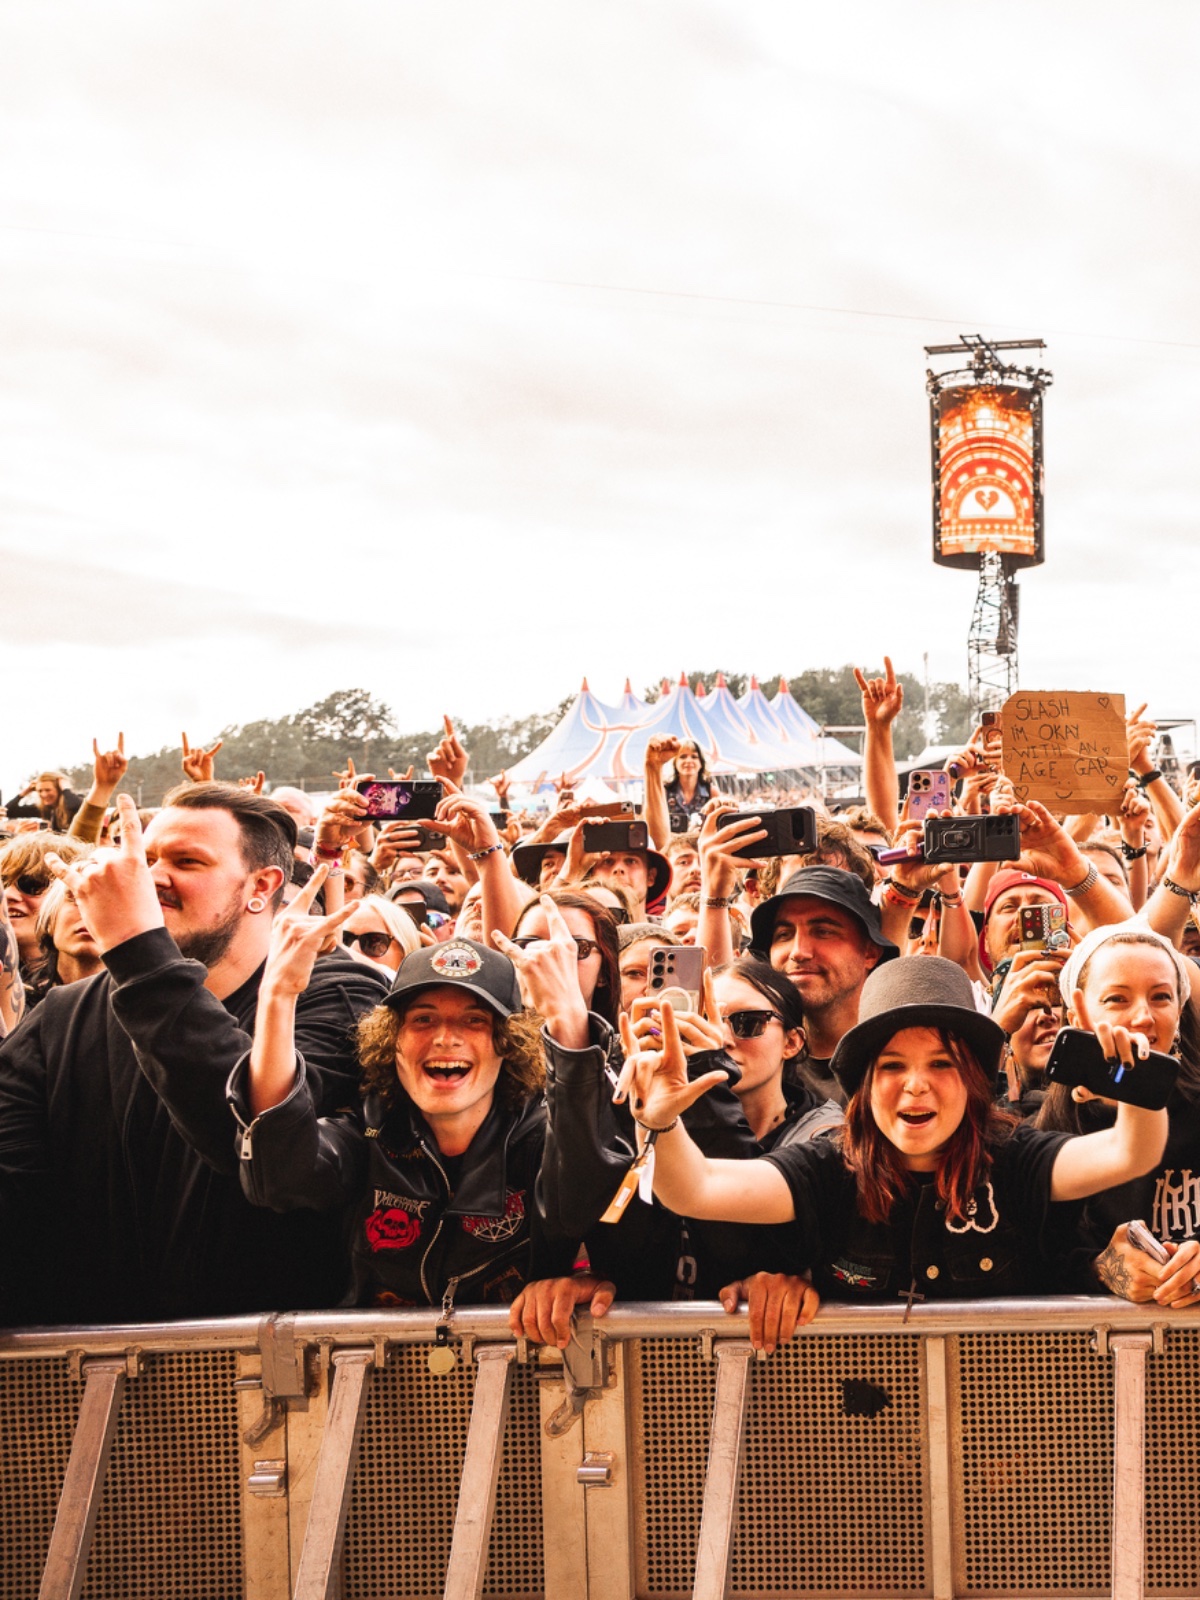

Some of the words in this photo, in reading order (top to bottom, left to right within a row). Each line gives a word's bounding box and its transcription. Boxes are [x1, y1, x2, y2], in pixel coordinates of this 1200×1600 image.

[1016, 699, 1070, 721] SLASH
[1038, 723, 1079, 741] OKAY
[1012, 743, 1062, 759] WITH
[1079, 741, 1098, 755] AN
[1020, 761, 1057, 781] AGE
[1074, 757, 1108, 776] GAP
